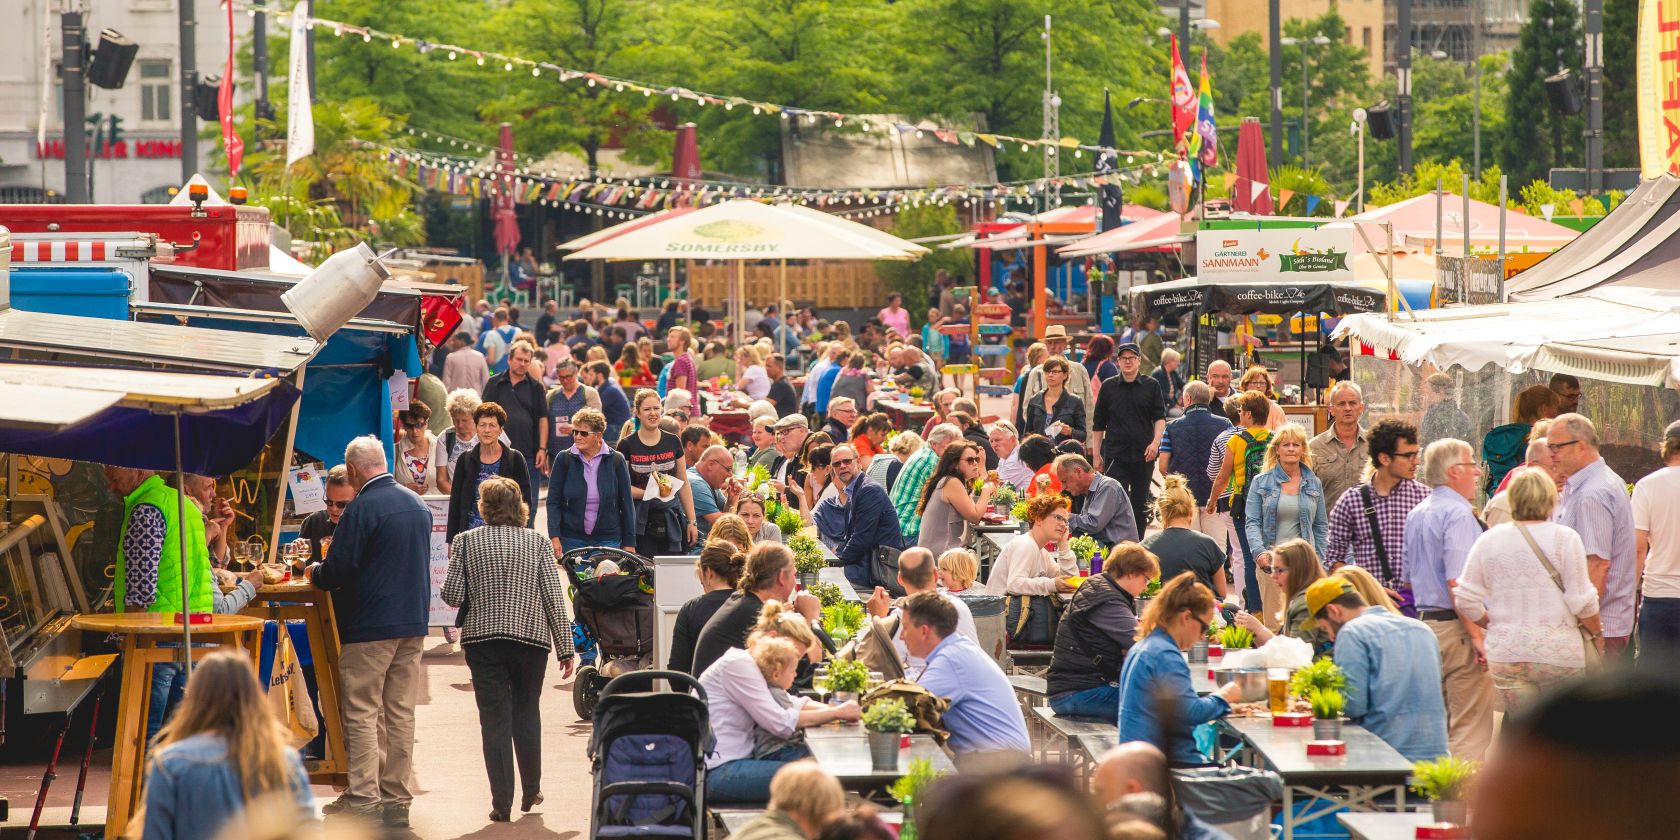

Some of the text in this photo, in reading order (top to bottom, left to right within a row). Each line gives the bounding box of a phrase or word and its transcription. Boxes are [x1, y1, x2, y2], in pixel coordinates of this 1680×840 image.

[666, 242, 779, 252] SOMERSBY
[1202, 258, 1259, 268] SANNMANN
[1153, 292, 1187, 306] coffee-bike
[1237, 289, 1284, 300] coffee-bike
